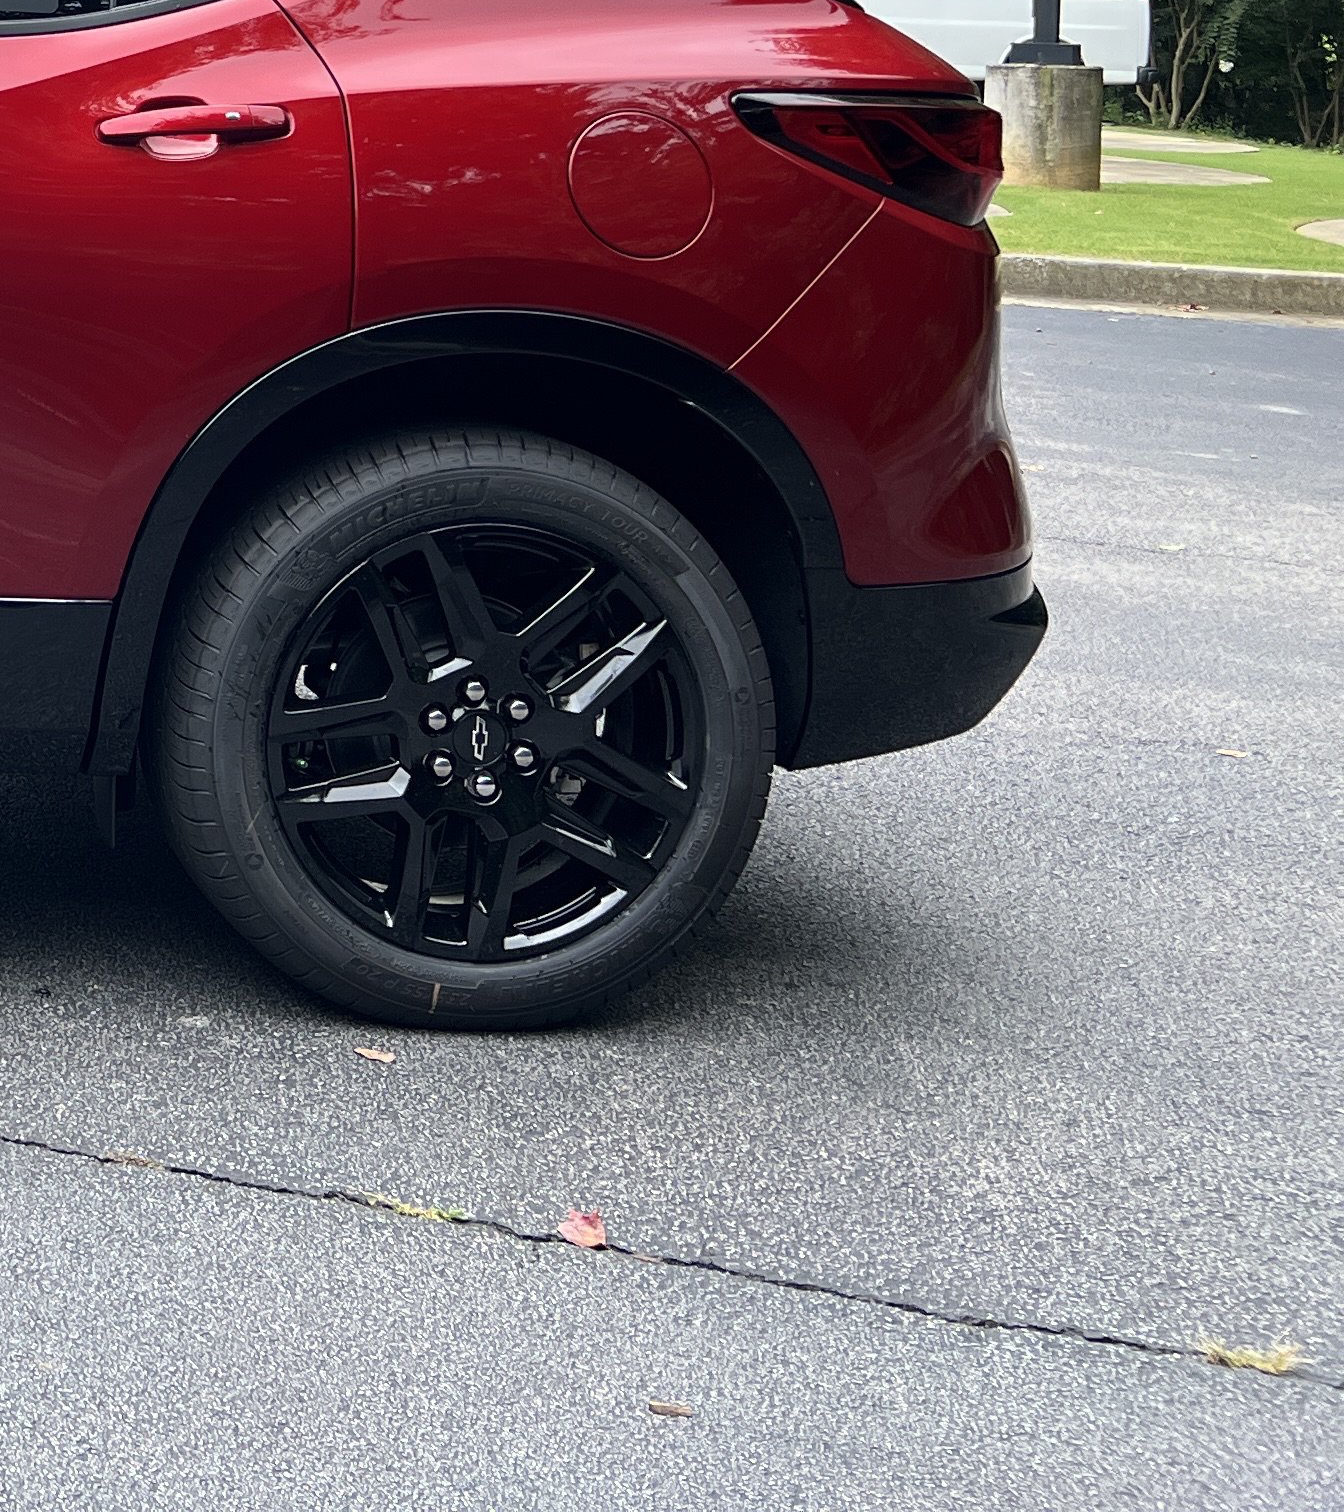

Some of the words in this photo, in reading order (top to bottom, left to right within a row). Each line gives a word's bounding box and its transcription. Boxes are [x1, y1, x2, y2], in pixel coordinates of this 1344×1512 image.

[330, 478, 480, 544] MICHELIN
[509, 484, 596, 514] PRIMACY
[599, 504, 649, 546] TOUR
